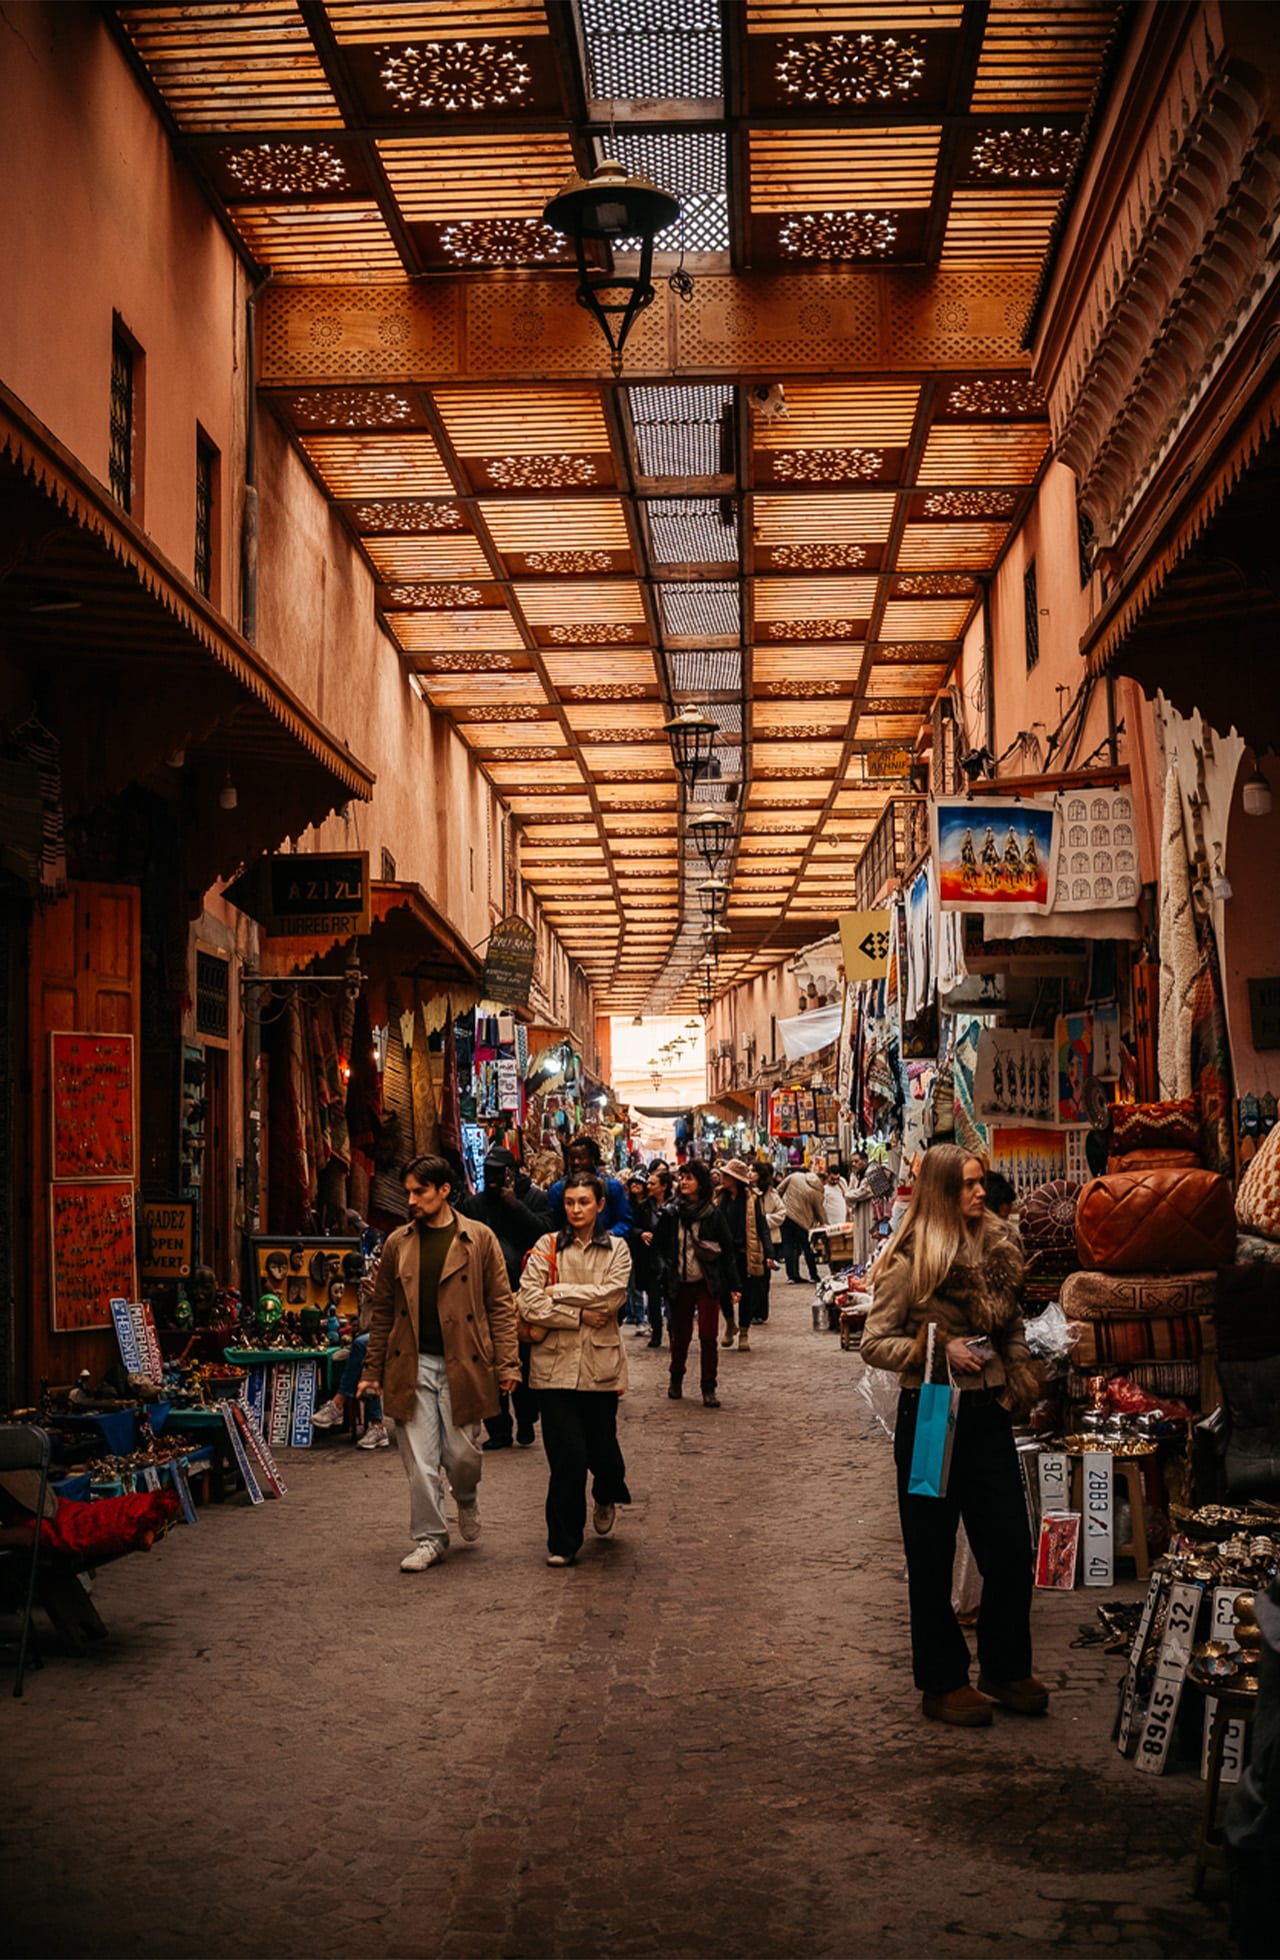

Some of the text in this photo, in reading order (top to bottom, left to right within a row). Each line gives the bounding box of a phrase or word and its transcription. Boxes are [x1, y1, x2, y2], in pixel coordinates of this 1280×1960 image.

[332, 915, 359, 934] ART
[145, 1209, 185, 1230] GADEZ
[271, 1374, 291, 1444] MARRAKECH
[295, 1360, 316, 1433] MARRAKECH
[1044, 1462, 1063, 1482] 26
[1089, 1471, 1108, 1511] 2883
[1089, 1557, 1108, 1577] 40
[1142, 1692, 1173, 1755] 8945
[1169, 1602, 1194, 1633] 32
